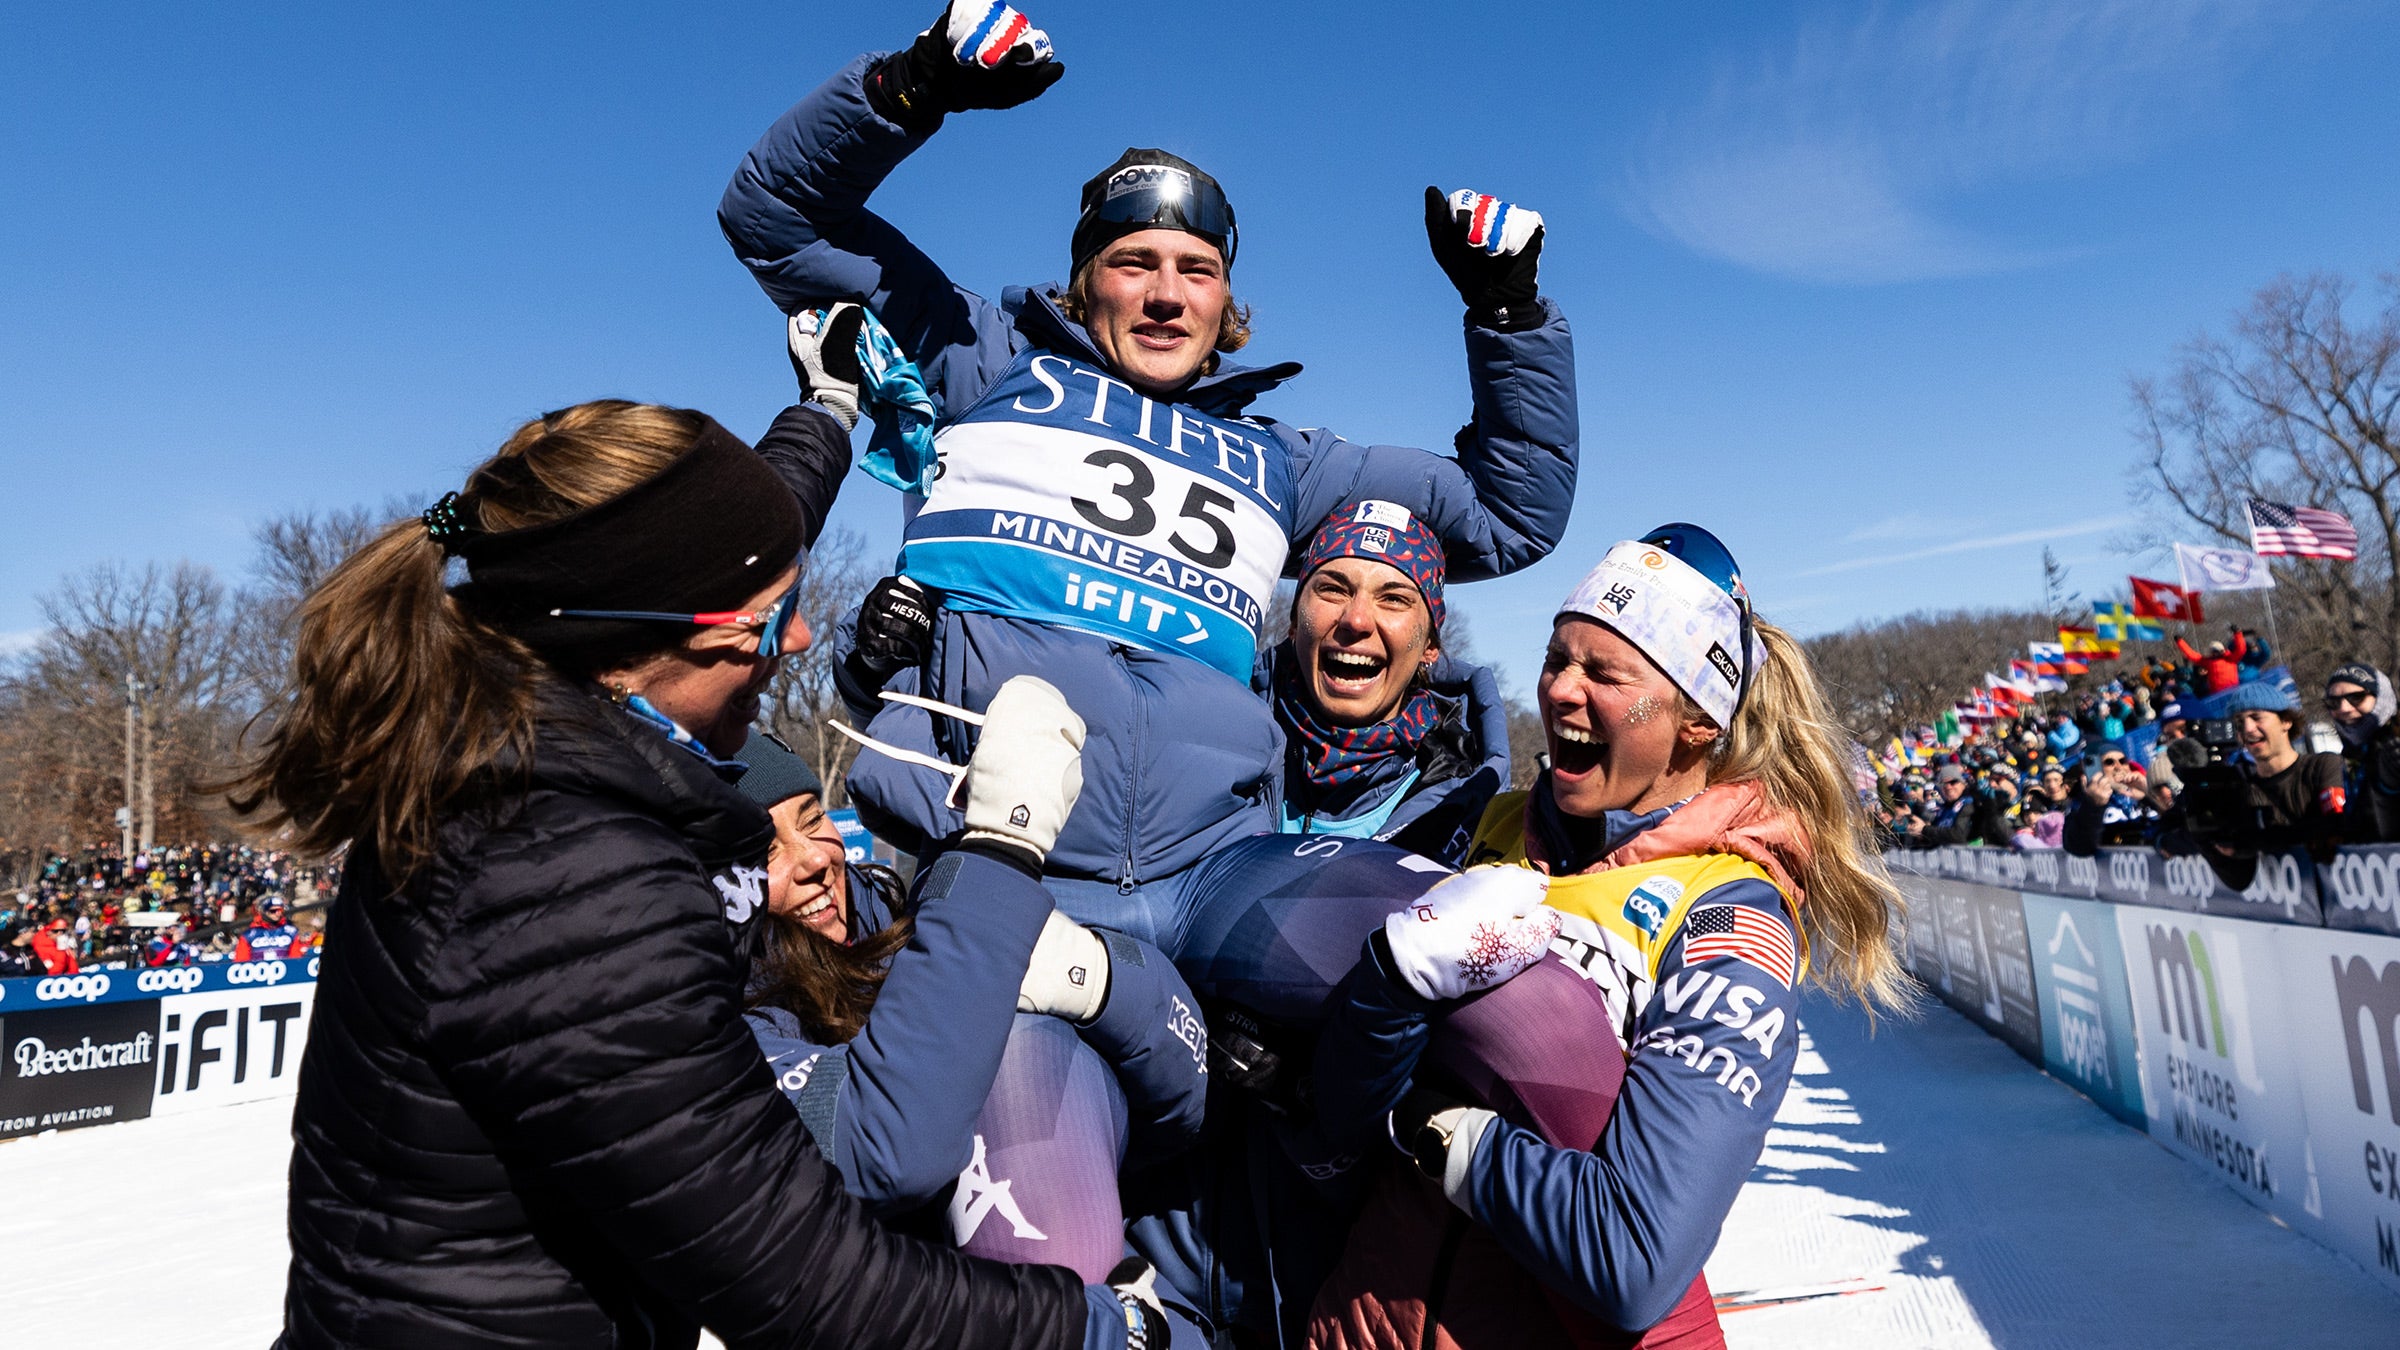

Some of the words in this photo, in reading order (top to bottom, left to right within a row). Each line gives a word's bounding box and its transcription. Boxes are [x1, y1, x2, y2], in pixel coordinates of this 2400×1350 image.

[1012, 353, 1283, 512] STIFEL
[1070, 448, 1237, 570] 35
[1366, 528, 1388, 539] US
[990, 511, 1262, 629] MINNEAPOLIS
[1617, 561, 1648, 578] Emily
[1610, 582, 1637, 601] US
[889, 601, 931, 631] HESTRA
[1710, 648, 1738, 686] SKIDA
[2110, 851, 2150, 901] coop
[35, 974, 111, 1002] coop
[137, 966, 204, 993] coop
[227, 960, 287, 986] coop
[1663, 970, 1786, 1060] VISA
[14, 1030, 152, 1078] Beechcraft
[40, 1104, 114, 1126] AVIATION
